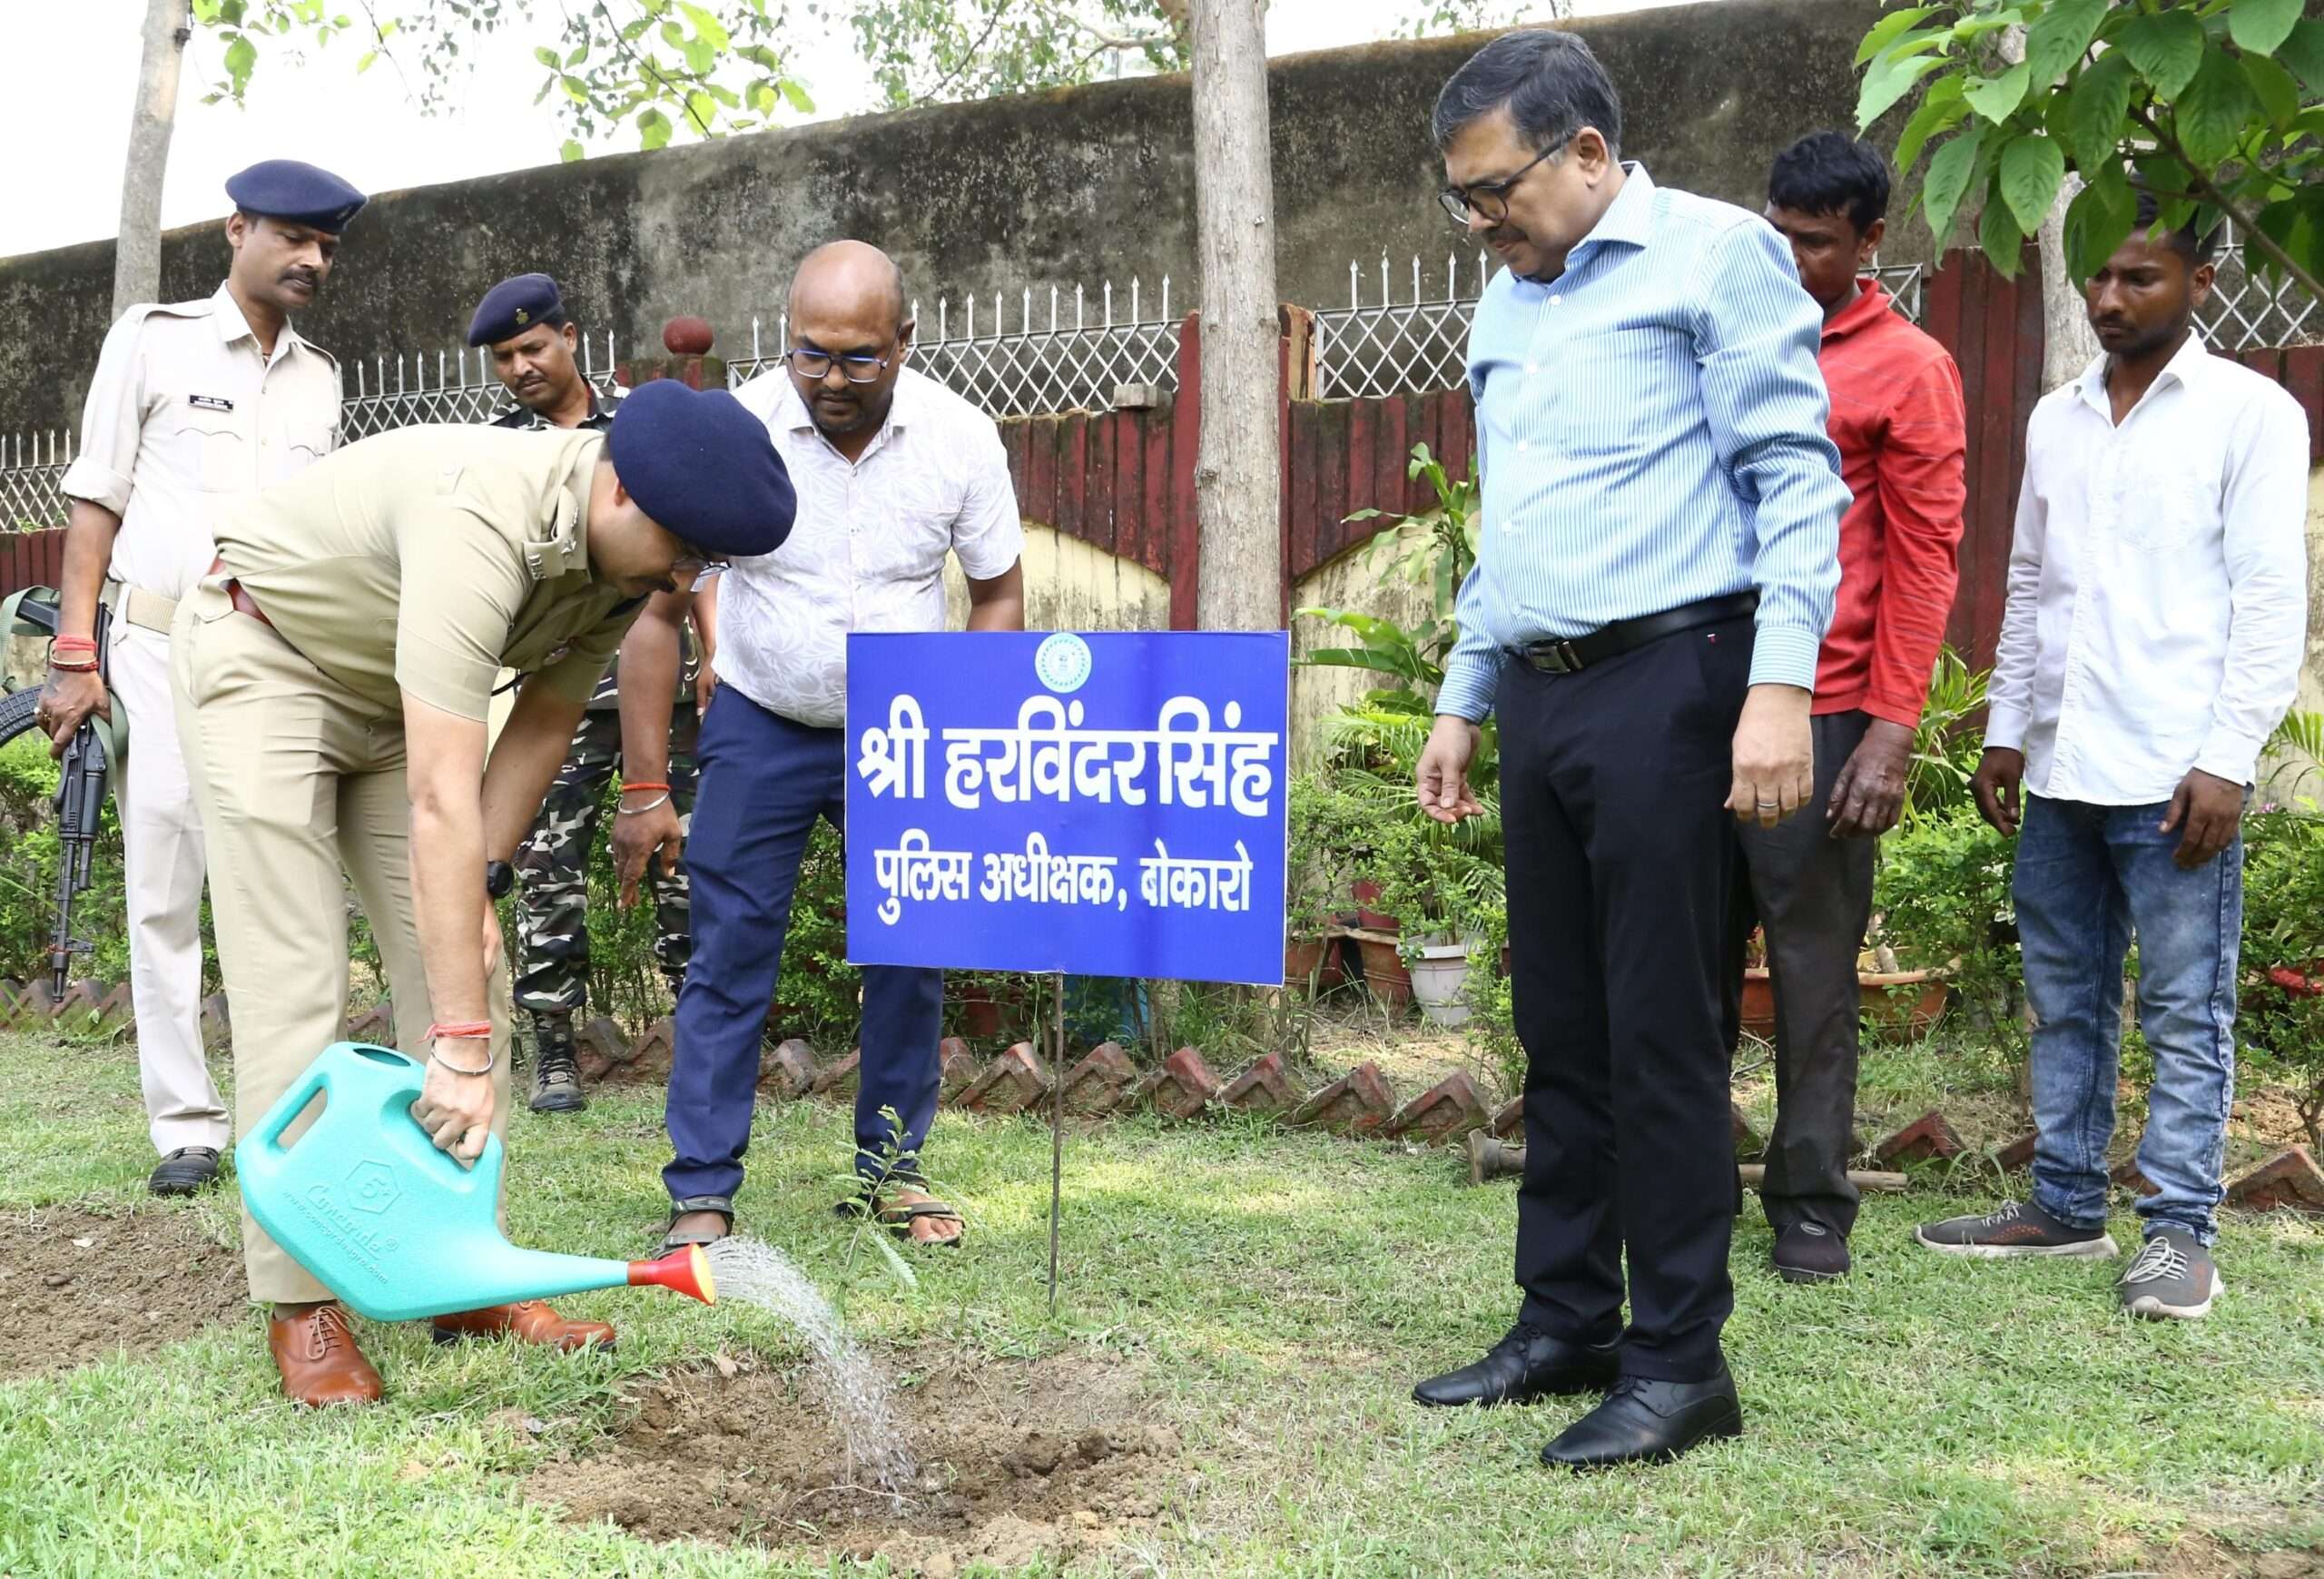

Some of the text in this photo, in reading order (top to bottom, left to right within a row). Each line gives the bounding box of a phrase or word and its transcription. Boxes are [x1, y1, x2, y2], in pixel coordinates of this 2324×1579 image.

[857, 694, 931, 799] श्री
[874, 828, 1254, 925] पुलिस अधीक्षक, बोकारो
